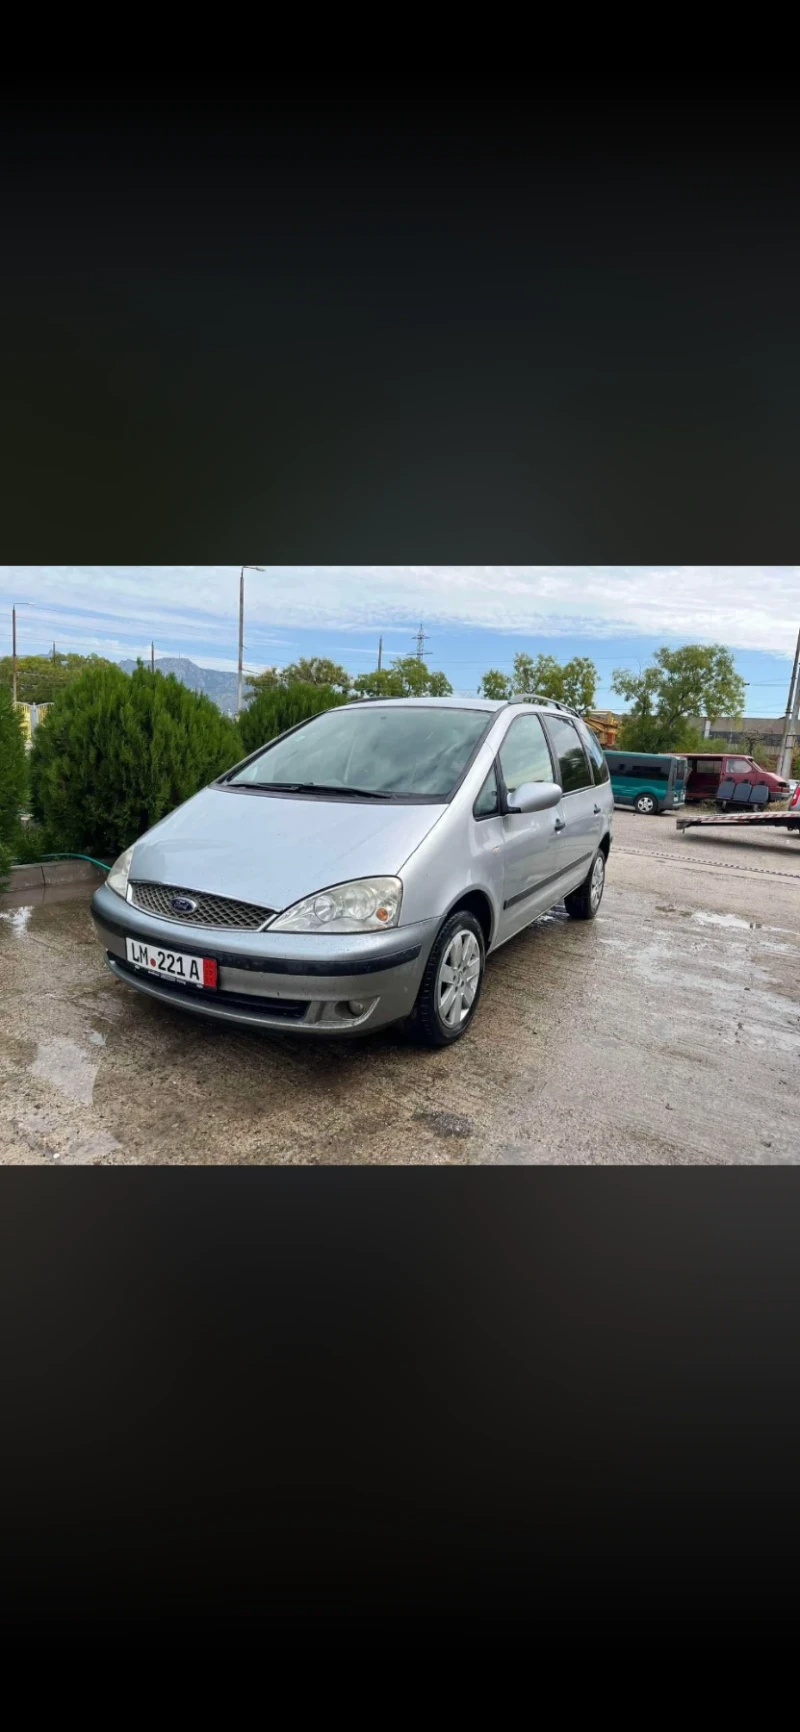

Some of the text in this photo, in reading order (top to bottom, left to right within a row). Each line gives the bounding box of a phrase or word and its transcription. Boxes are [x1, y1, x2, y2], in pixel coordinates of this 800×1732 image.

[131, 942, 149, 966] LM
[157, 951, 186, 977] 221
[189, 959, 200, 980] A
